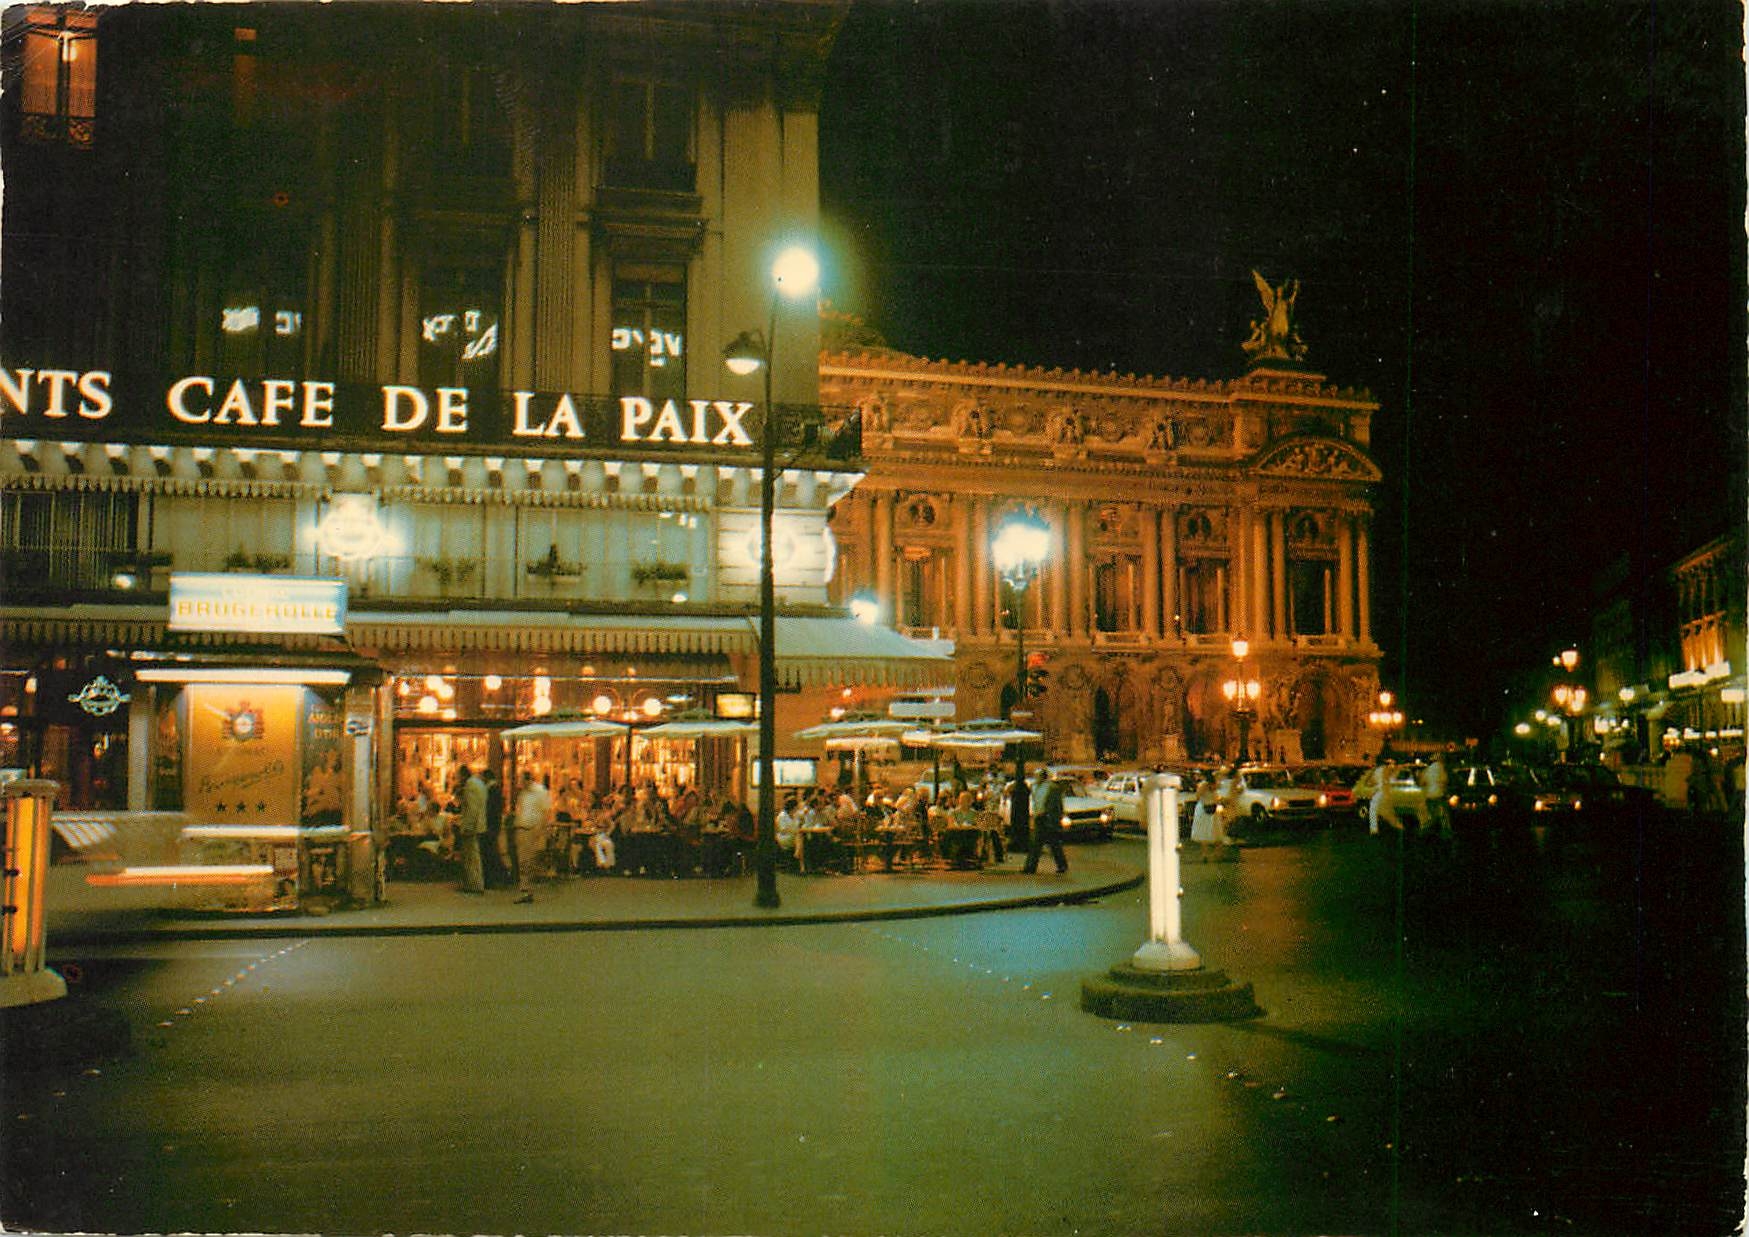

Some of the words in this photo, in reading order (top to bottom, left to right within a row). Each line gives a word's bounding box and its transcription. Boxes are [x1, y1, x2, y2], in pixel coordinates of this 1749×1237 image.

[0, 369, 112, 419] NTS
[168, 377, 335, 427] CAFE
[382, 386, 467, 431] DE
[512, 391, 585, 438] LA
[620, 397, 754, 446] PAIX
